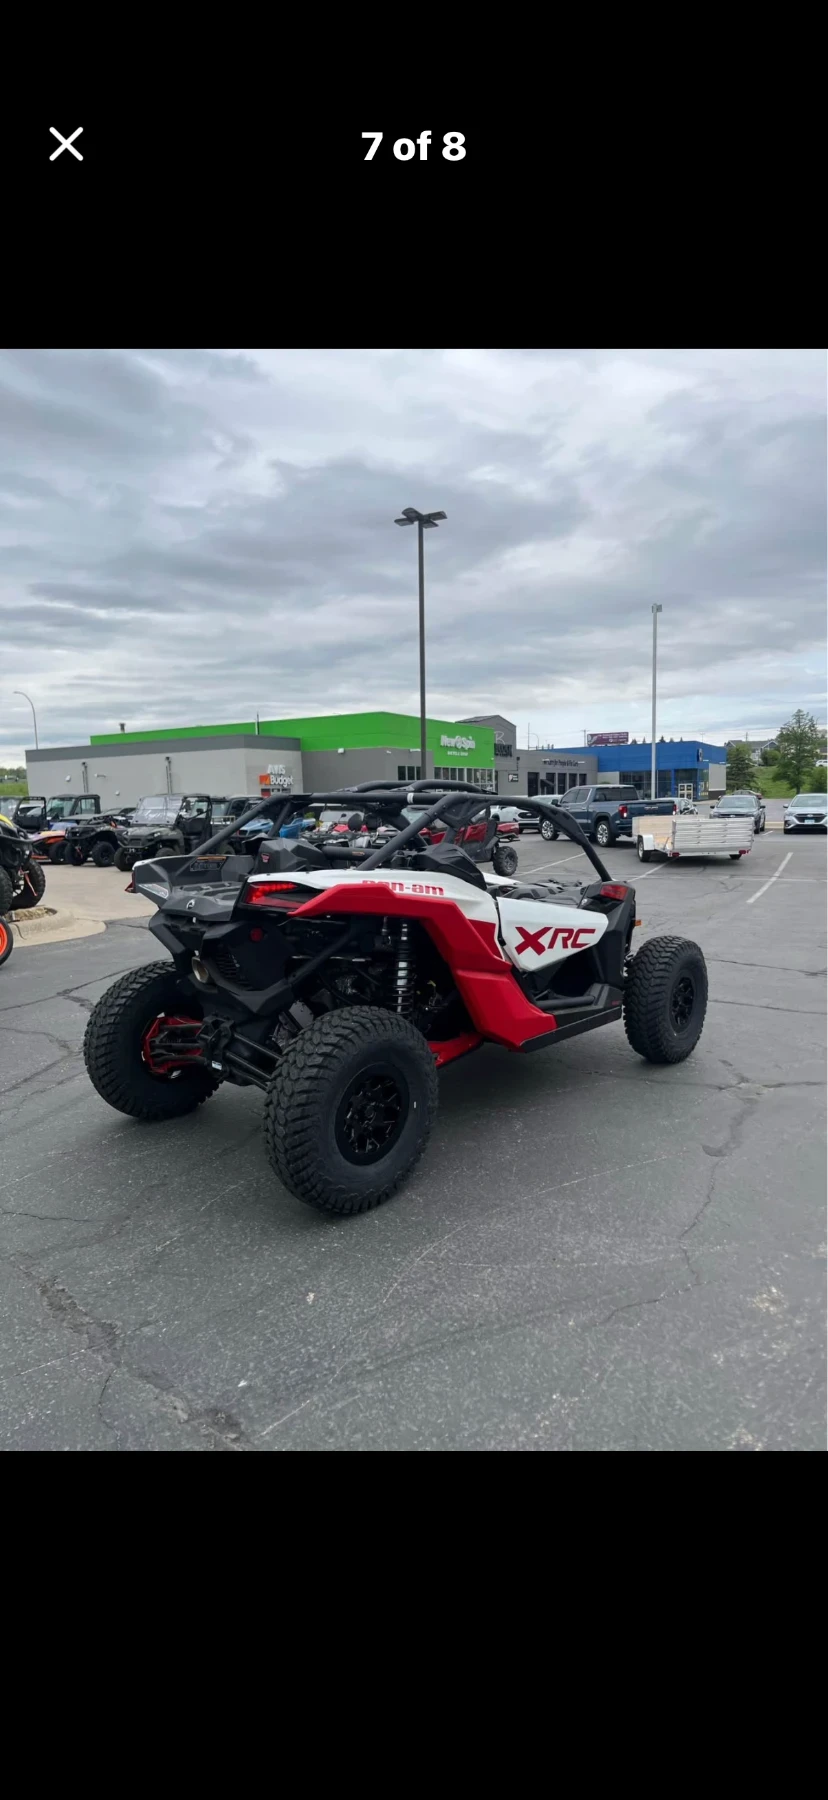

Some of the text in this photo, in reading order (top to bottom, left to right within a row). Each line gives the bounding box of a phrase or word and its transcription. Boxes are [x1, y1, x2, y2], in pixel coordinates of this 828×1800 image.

[267, 764, 286, 774] AVIS
[270, 774, 294, 788] Budget
[514, 926, 597, 956] XRC
